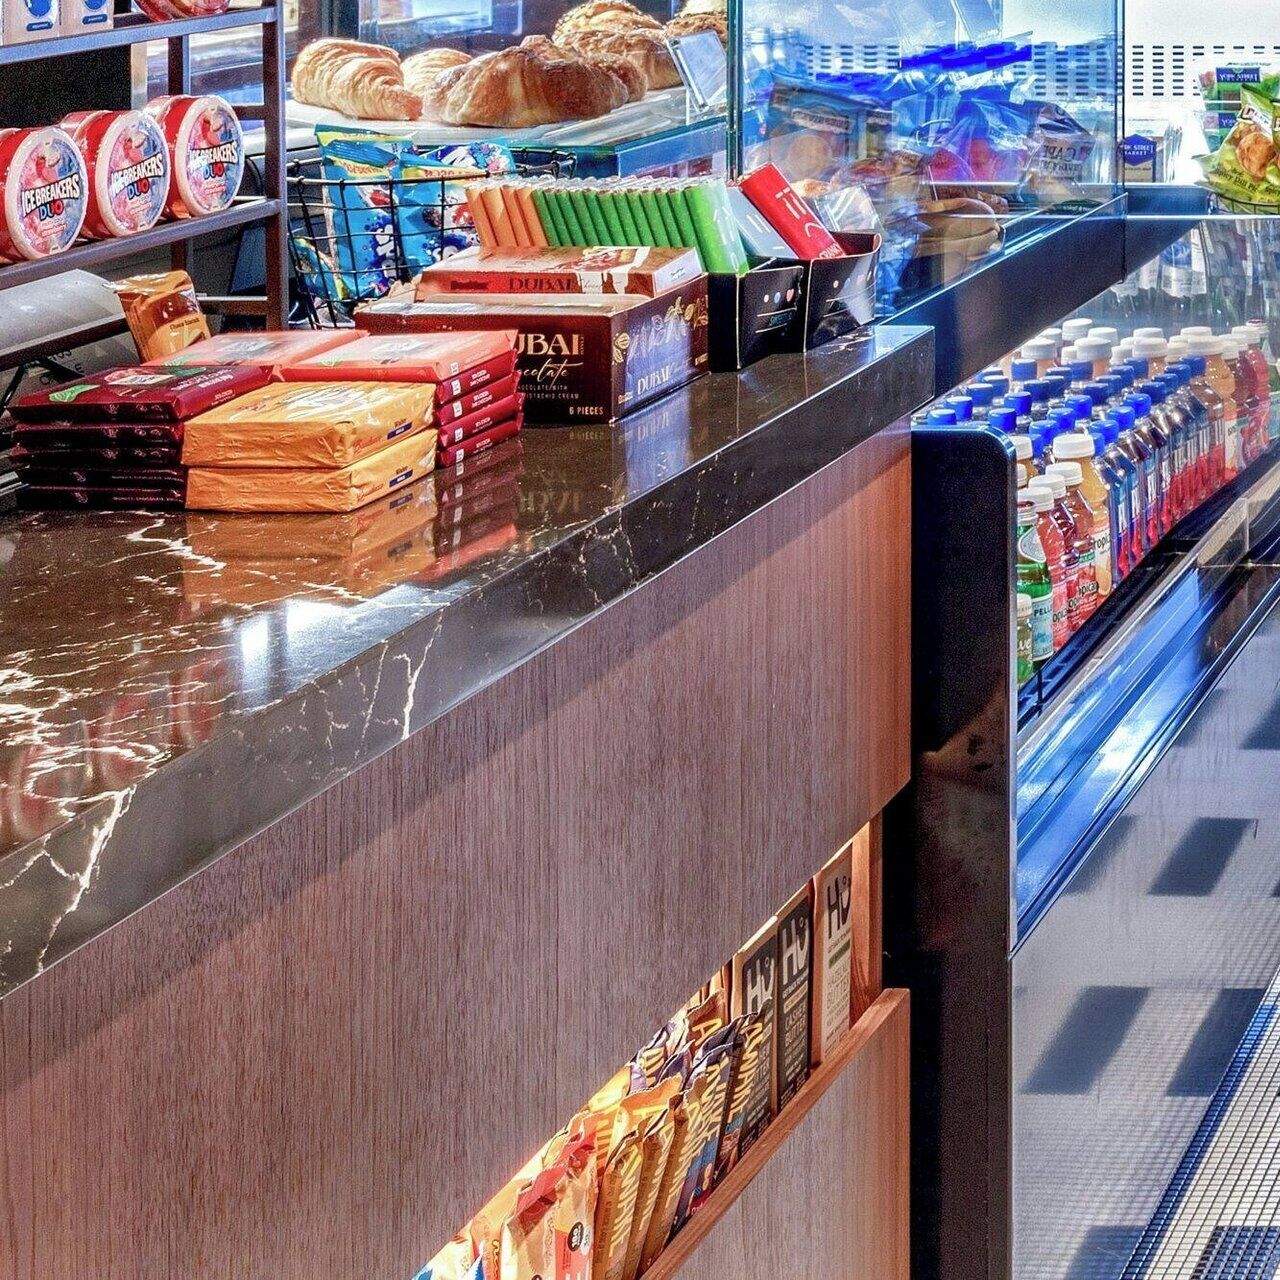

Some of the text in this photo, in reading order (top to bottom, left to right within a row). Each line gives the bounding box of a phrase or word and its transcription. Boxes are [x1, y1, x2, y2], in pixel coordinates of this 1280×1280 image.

[203, 163, 224, 180] DUO
[127, 181, 150, 202] DUO
[39, 202, 64, 220] DUO
[509, 278, 571, 291] DUBAI
[518, 334, 579, 355] UBAI
[638, 366, 670, 395] DUBAI
